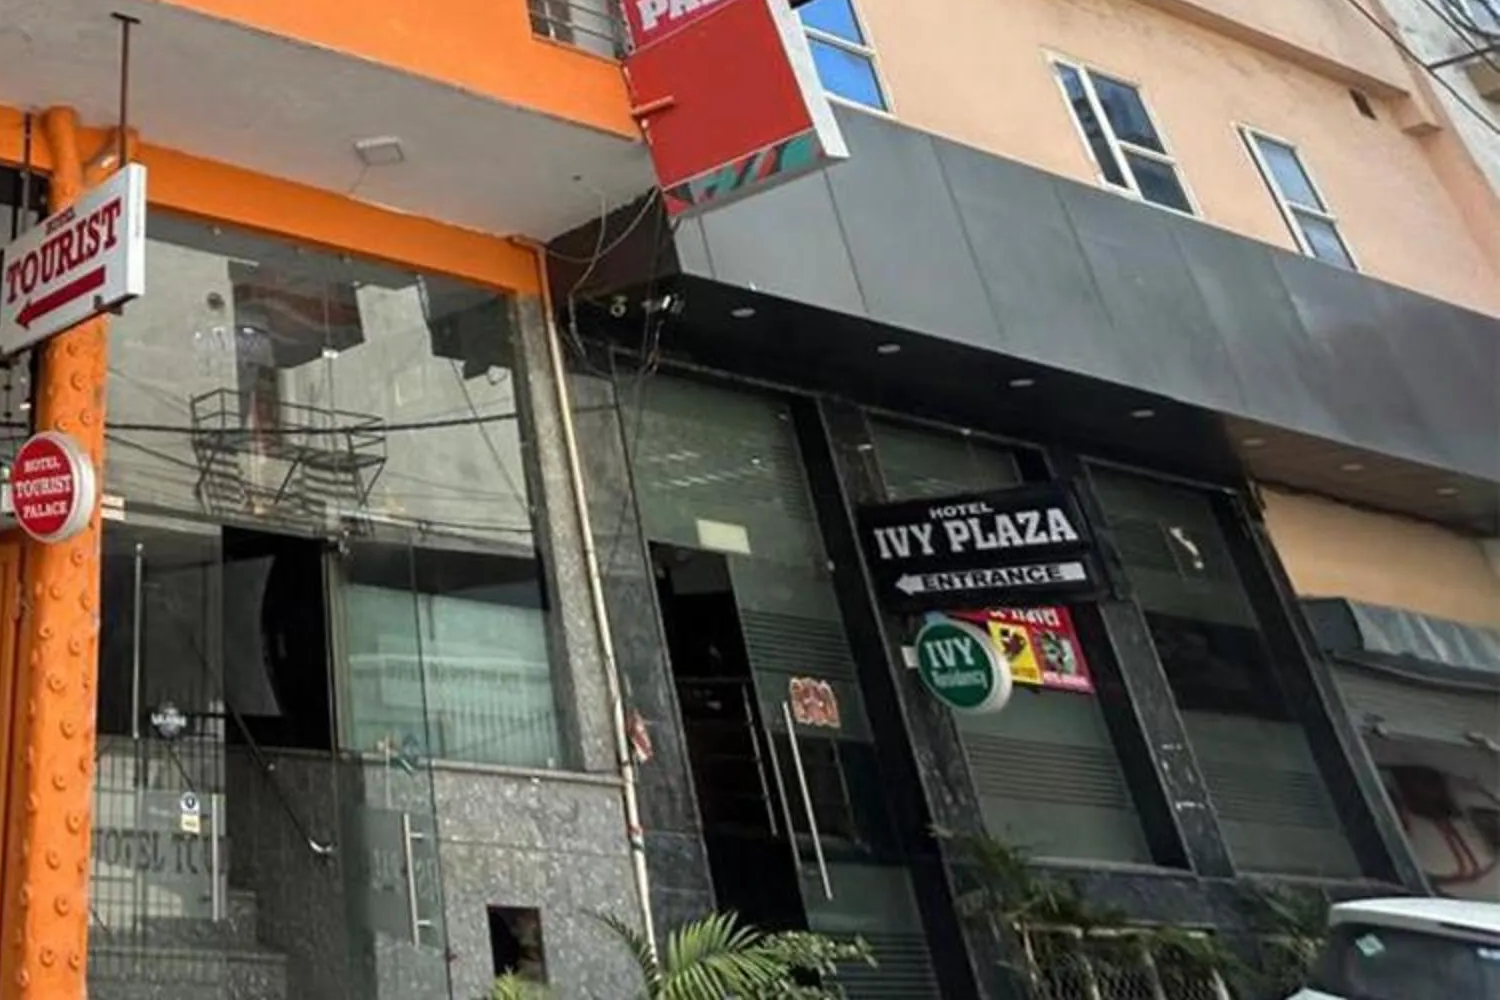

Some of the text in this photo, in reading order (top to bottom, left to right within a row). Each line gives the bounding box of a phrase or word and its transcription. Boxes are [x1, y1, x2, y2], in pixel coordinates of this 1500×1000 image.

[5, 197, 122, 303] TOURIST
[23, 456, 62, 472] HOTEL
[15, 474, 72, 498] TOURIST
[22, 500, 68, 519] PALACE
[929, 501, 994, 520] HOTEL
[873, 507, 1078, 560] IVY PLAZA
[921, 565, 1066, 592] ENTRANCE
[923, 635, 976, 669] IVY
